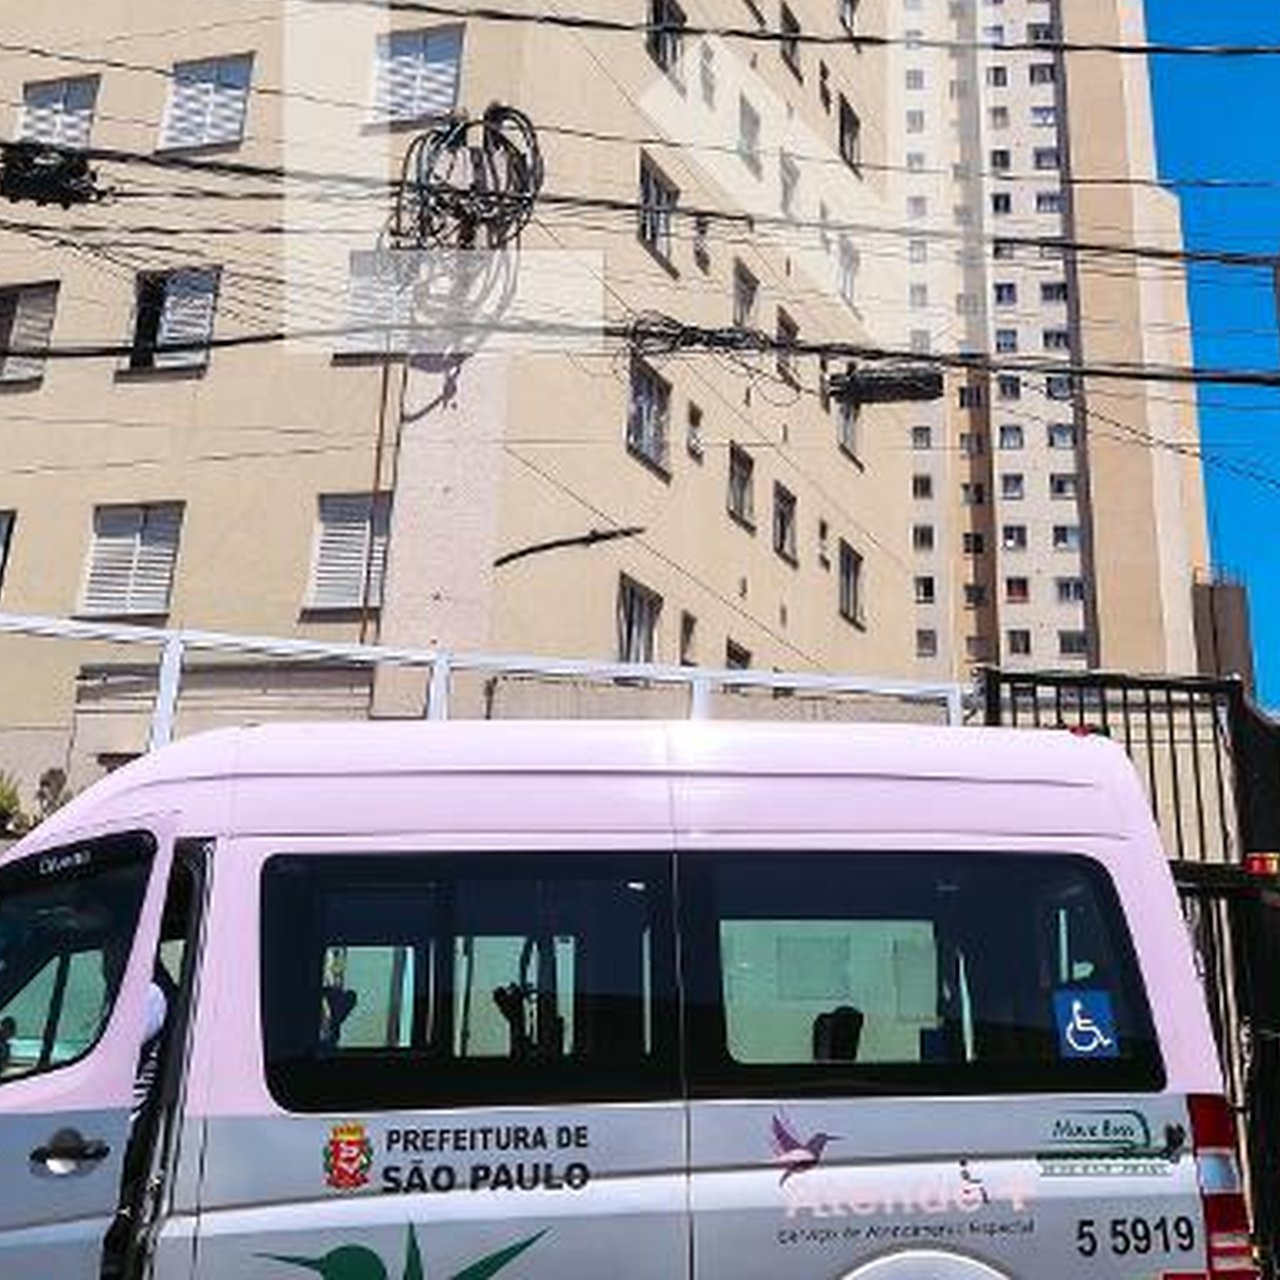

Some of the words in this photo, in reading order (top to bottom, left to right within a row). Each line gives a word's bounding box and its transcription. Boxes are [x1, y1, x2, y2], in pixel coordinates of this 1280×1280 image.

[385, 1126, 548, 1153] PREFEITURA
[556, 1125, 589, 1150] DE
[381, 1159, 457, 1194] SÃO
[469, 1162, 591, 1191] PAULO
[1076, 1219, 1099, 1257] 5
[1109, 1215, 1195, 1256] 5919
